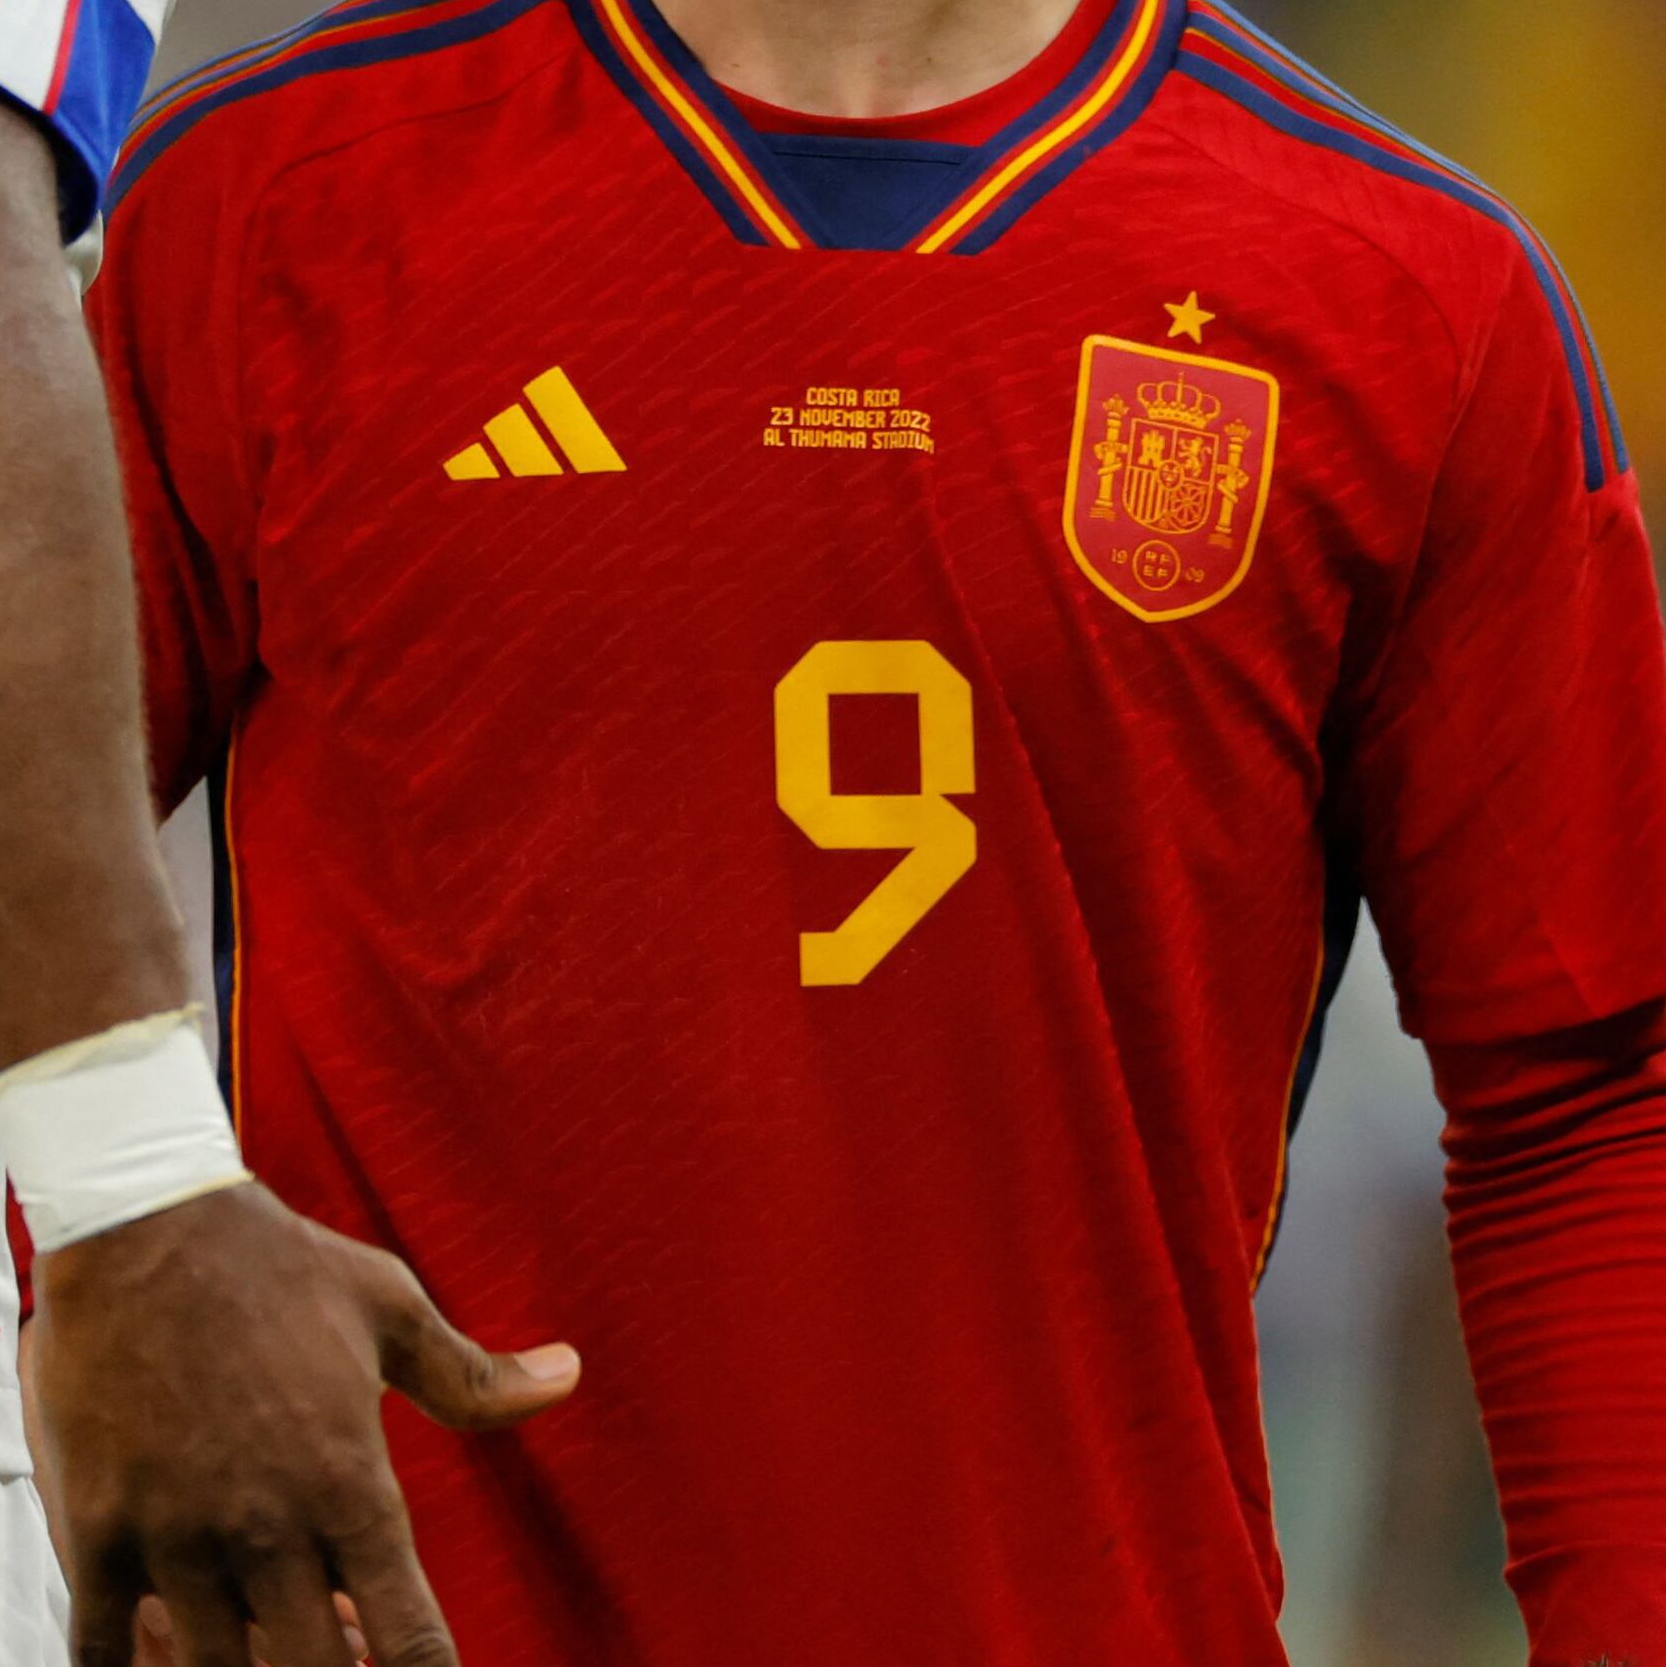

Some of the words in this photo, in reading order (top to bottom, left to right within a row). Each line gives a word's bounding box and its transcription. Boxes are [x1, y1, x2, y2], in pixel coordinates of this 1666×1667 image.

[806, 387, 858, 406] COSTA
[863, 388, 900, 407] RICA
[770, 407, 794, 425] 23
[799, 408, 886, 428] NOVEMBER
[890, 409, 931, 432] 2022
[763, 428, 785, 447] AL
[789, 428, 867, 449] THUMAMA
[872, 431, 935, 454] STADIUM
[1110, 547, 1129, 565] 19
[774, 639, 978, 987] 9
